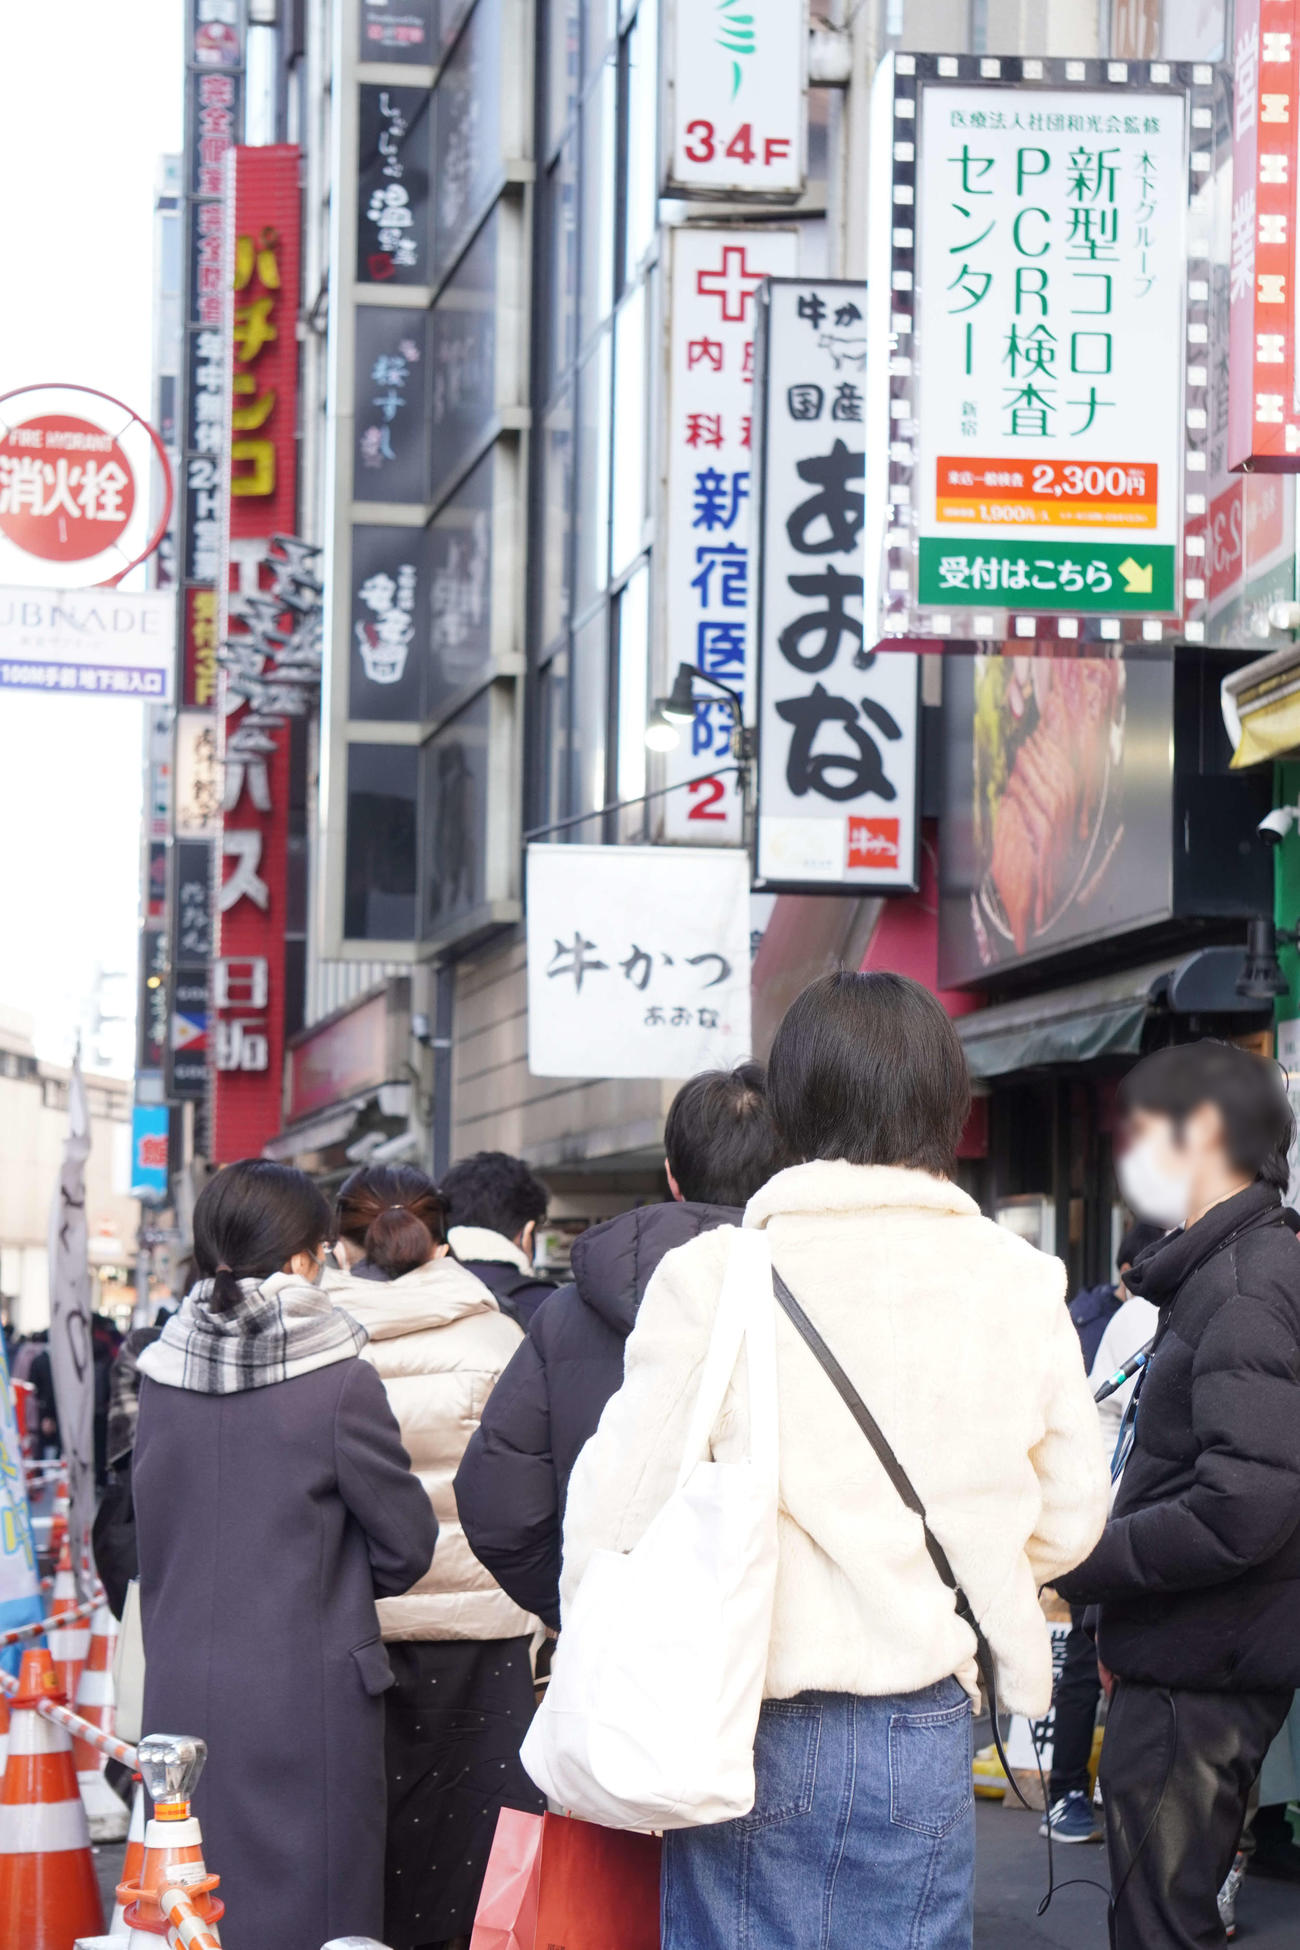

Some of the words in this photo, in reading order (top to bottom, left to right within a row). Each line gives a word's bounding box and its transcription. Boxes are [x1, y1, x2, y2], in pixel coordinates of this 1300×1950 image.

[946, 144, 997, 376] センター
[1001, 147, 1058, 438] PCR検査
[1065, 145, 1122, 437] 新型コロナ
[232, 225, 280, 497] パチンコ
[685, 336, 724, 449] 内科
[0, 456, 128, 522] 消火栓
[8, 427, 43, 449] FIRE
[774, 438, 902, 802] あおな
[938, 555, 1113, 593] 受付はこちら
[547, 931, 731, 996] 牛かつ
[644, 1005, 720, 1029] あおな
